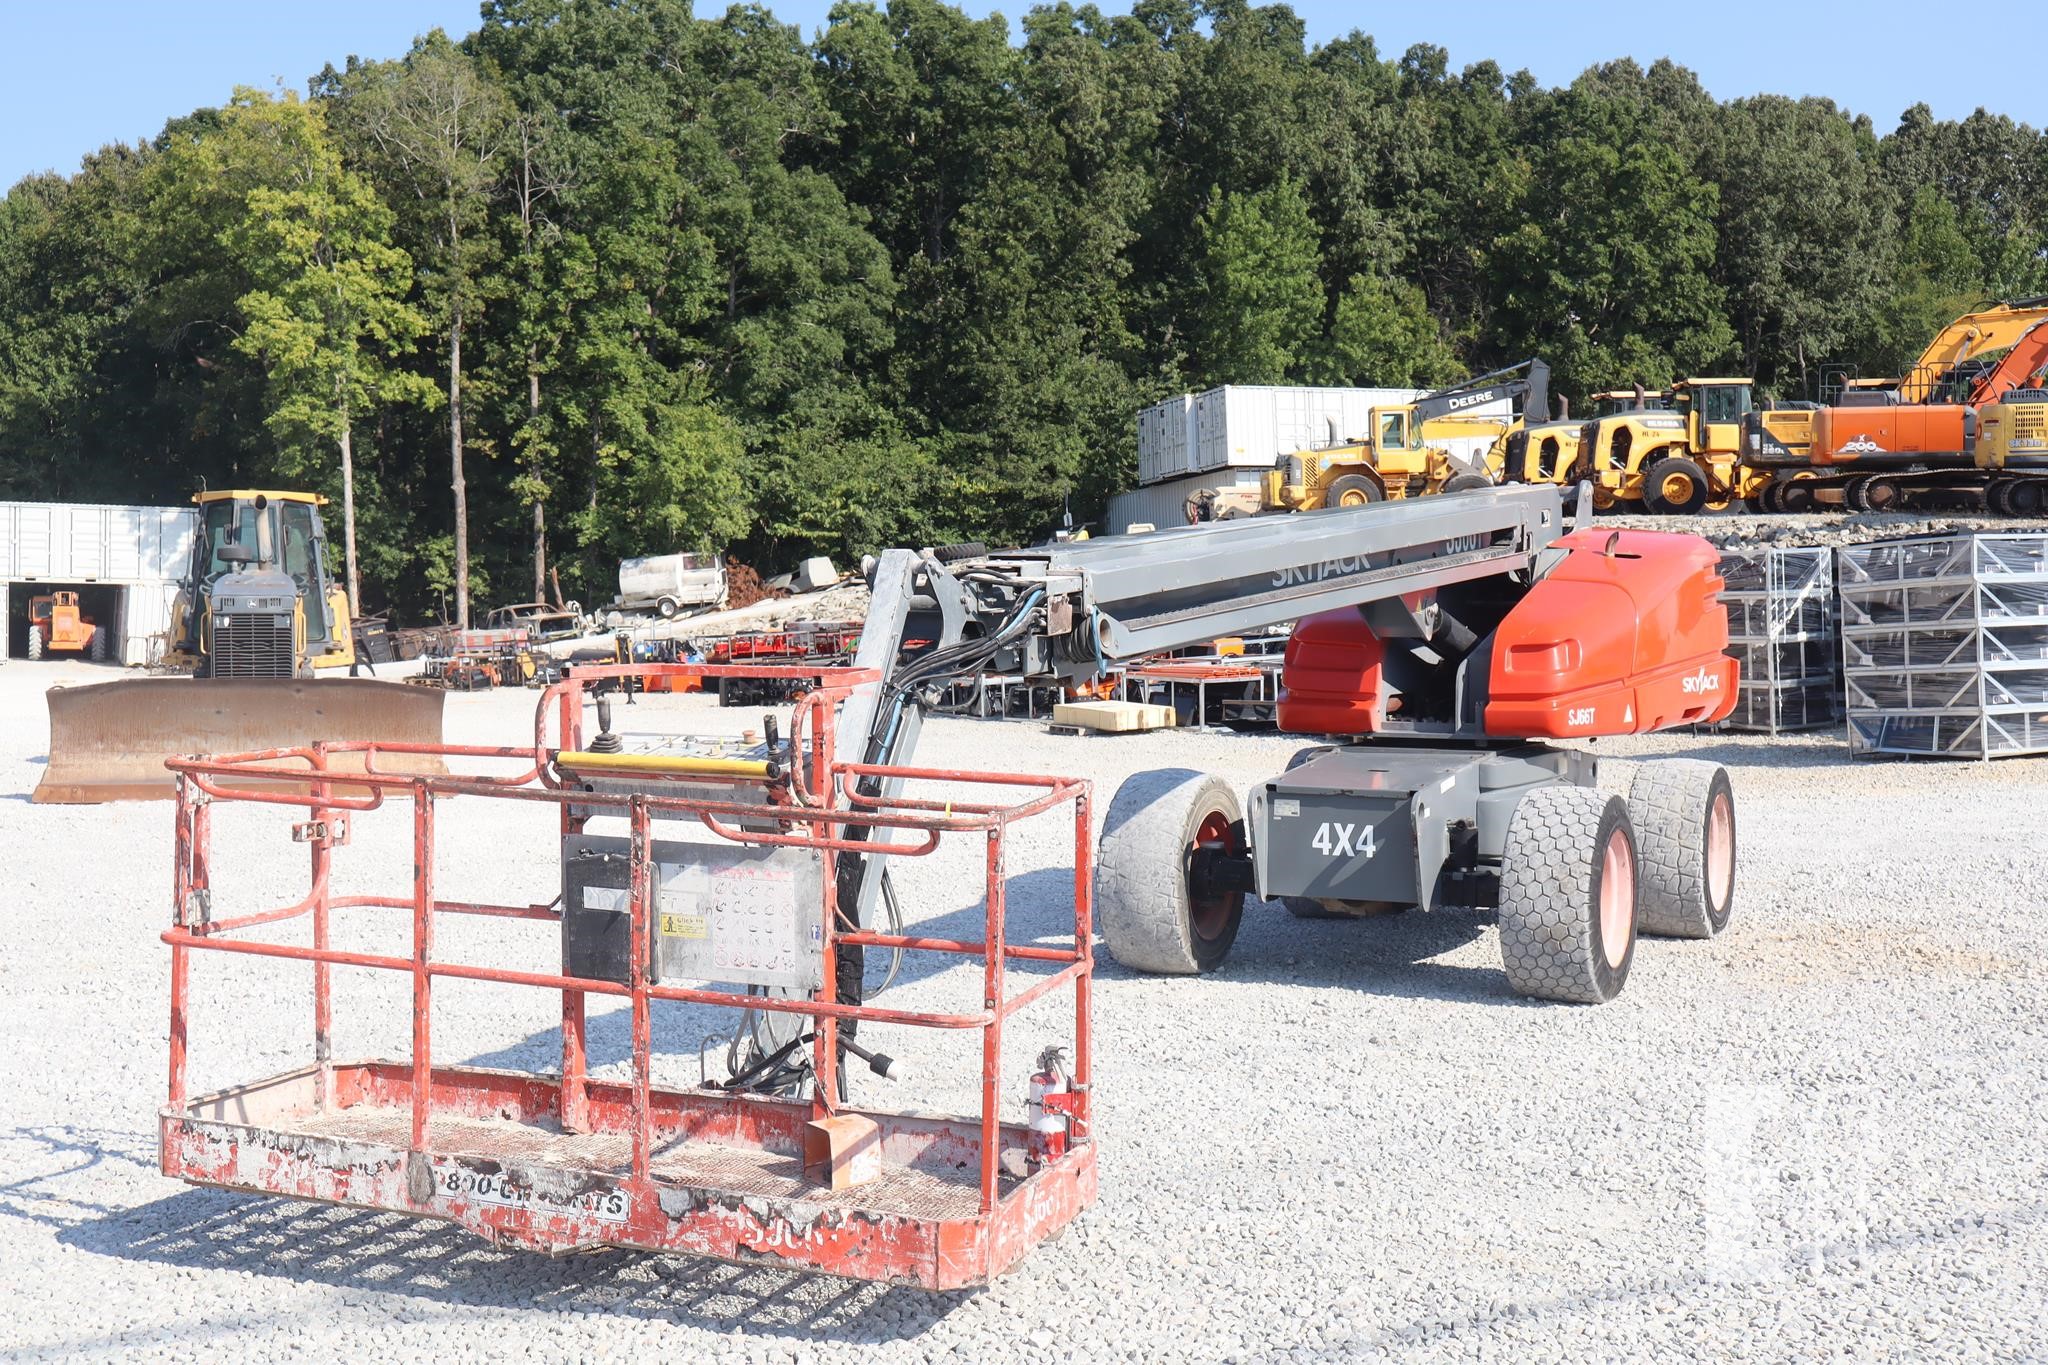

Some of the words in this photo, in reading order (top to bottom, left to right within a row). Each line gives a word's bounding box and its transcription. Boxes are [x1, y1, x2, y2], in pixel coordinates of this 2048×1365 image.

[1448, 390, 1494, 410] DEERE
[1845, 441, 1877, 452] 200
[1682, 667, 1719, 695] SKYJACK
[1568, 708, 1596, 726] SJ66T
[1311, 822, 1377, 858] 4X4
